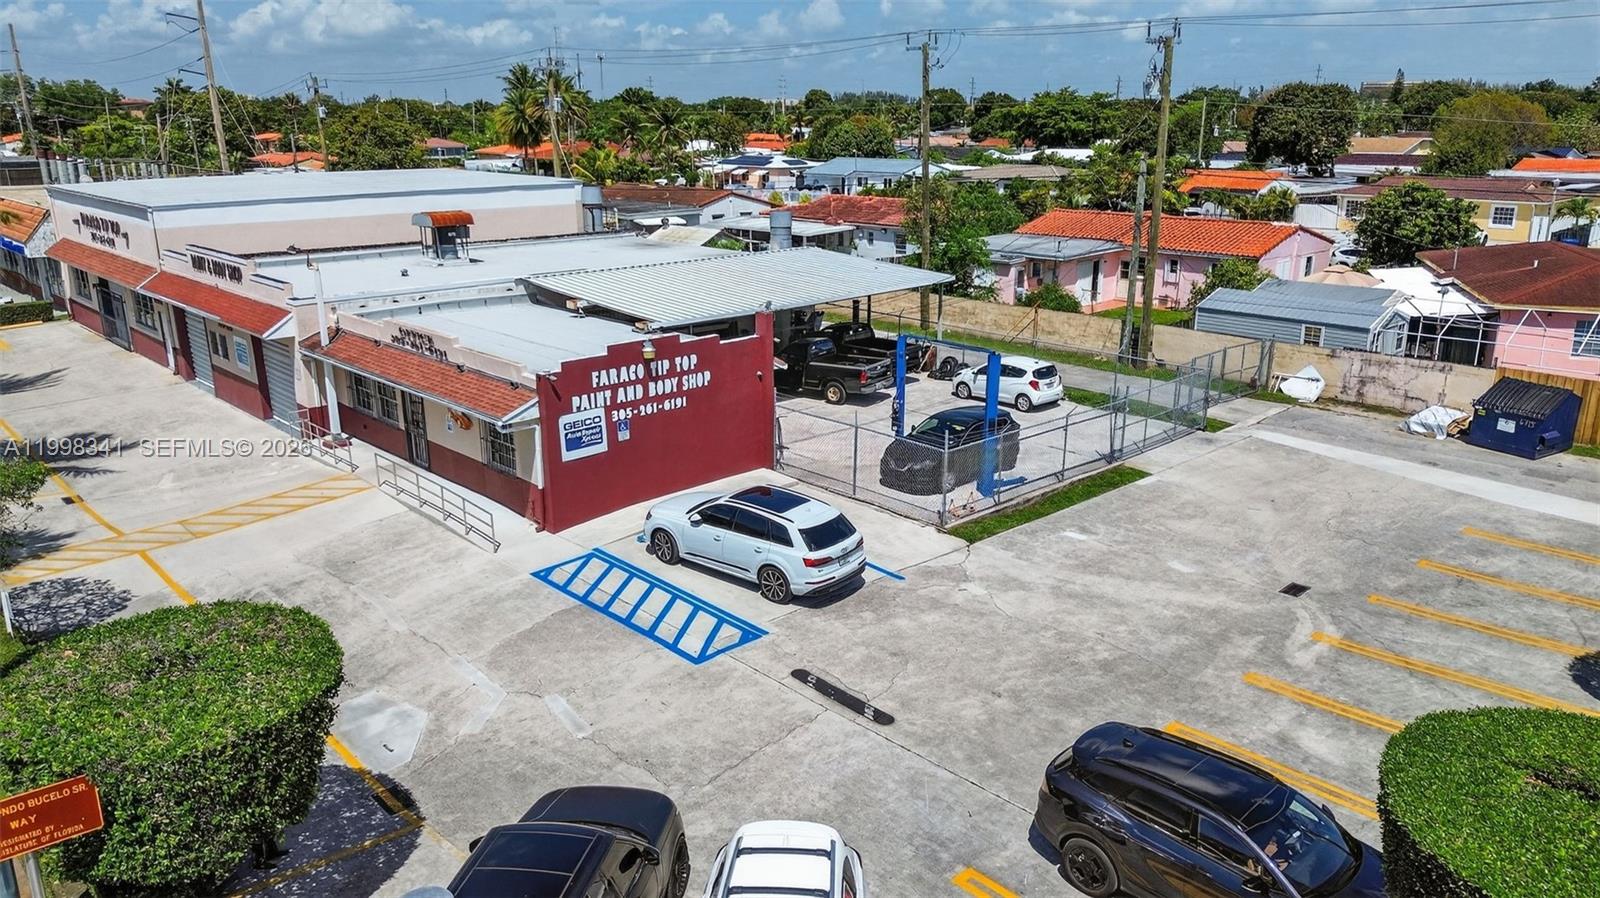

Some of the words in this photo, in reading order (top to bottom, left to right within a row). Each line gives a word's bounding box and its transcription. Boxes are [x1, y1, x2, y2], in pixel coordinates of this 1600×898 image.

[591, 363, 645, 388] FARACO
[650, 359, 671, 377] TIP
[675, 354, 698, 372] TOP
[571, 390, 612, 413] PAINT
[617, 384, 644, 403] AND
[648, 377, 679, 397] BODY
[682, 370, 711, 391] SHOP
[611, 396, 687, 422] 305-261-6191
[563, 415, 602, 431] GEICO
[27, 788, 70, 808] BUCELO
[72, 783, 89, 794] SR.
[9, 814, 37, 830] WAY
[40, 834, 50, 843] OF
[54, 823, 84, 838] FLORIDA
[45, 825, 55, 833] BY
